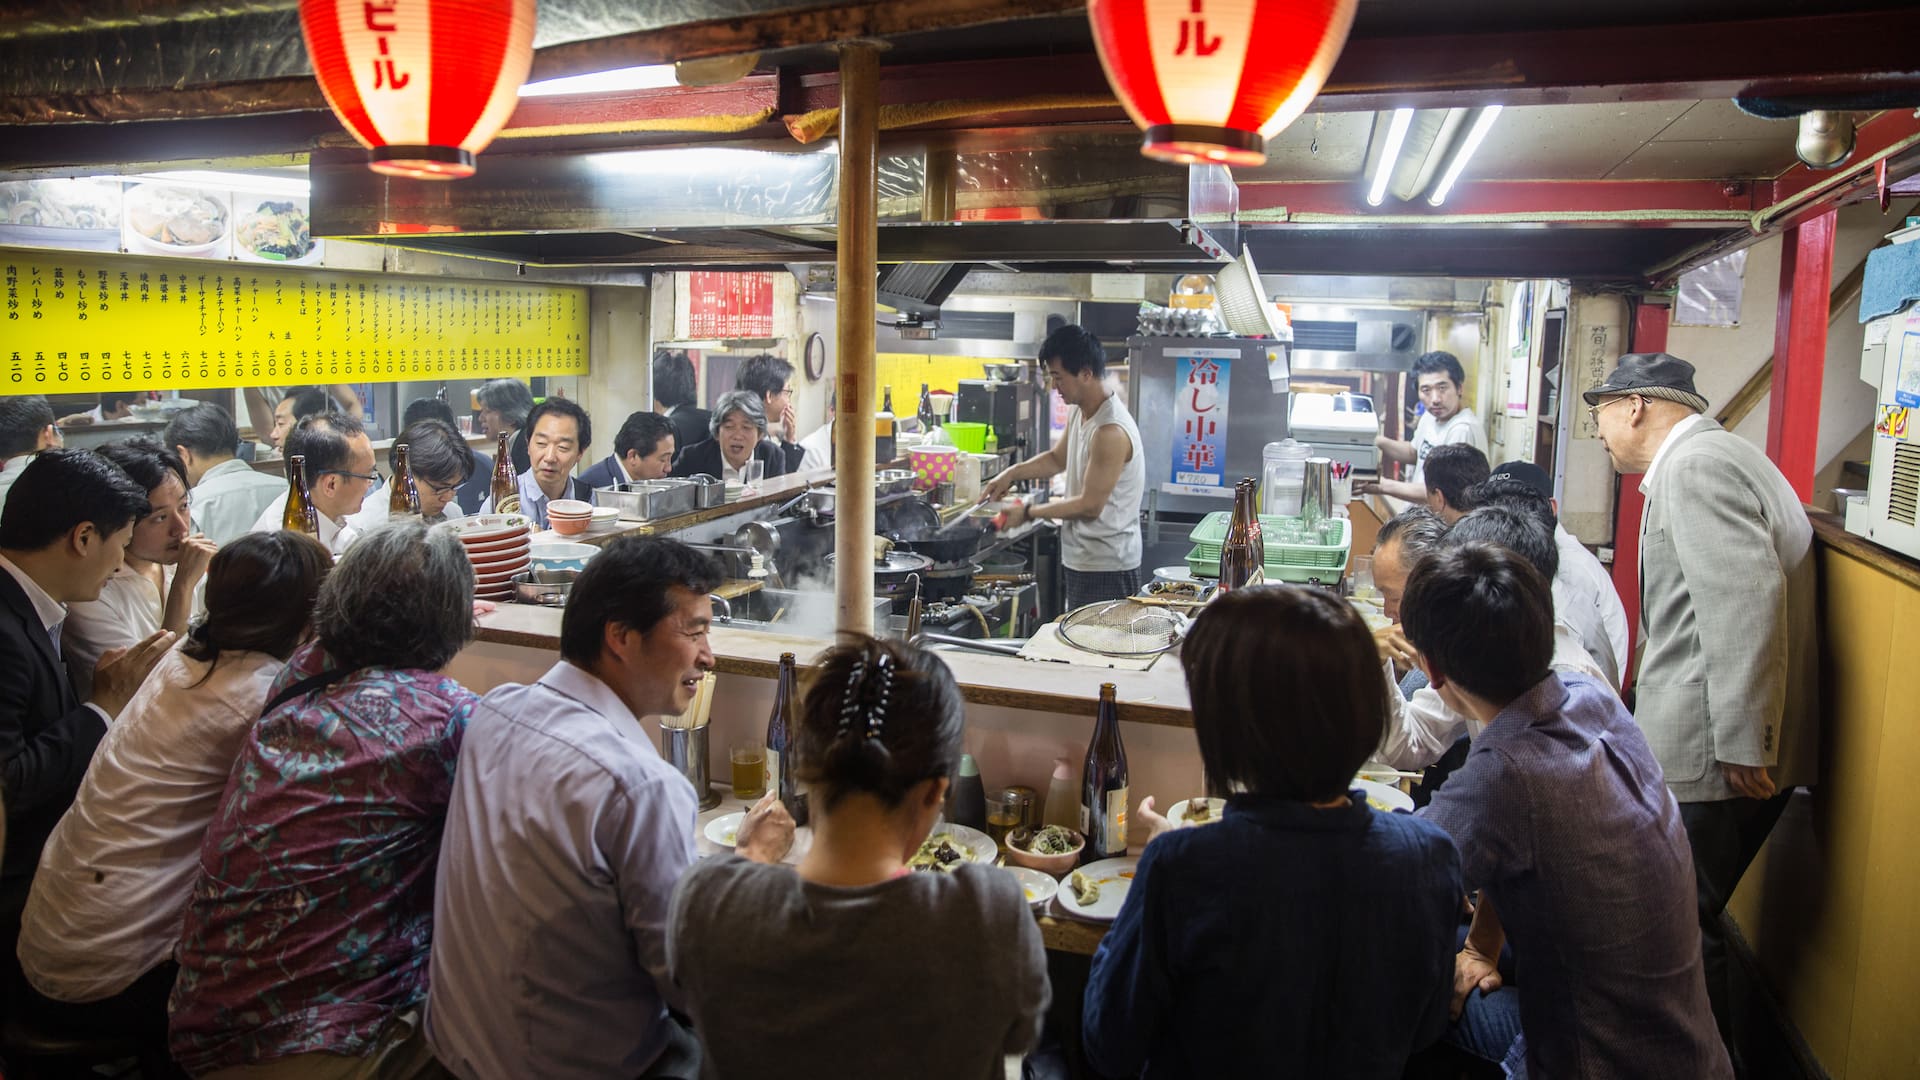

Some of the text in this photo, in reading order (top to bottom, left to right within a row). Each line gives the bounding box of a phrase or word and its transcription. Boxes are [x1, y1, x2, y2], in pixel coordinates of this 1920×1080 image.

[7, 265, 22, 382] 肉野菜炒め 五二〇
[32, 267, 46, 382] レバー炒め 五二〇
[77, 269, 90, 380] もやし炒め 四二〇
[98, 270, 111, 380] 野菜炒め 四二〇
[120, 272, 132, 379] 天津丼 七七〇
[140, 273, 152, 379] 焼肉丼 七二〇
[160, 273, 171, 379] 麻婆丼 七二〇
[179, 274, 190, 378] 中華丼 六二〇
[198, 276, 208, 377] ザーサイチャーハン 七二〇
[216, 276, 224, 333] キムチチャーハン
[58, 352, 68, 381] 四七〇
[268, 350, 276, 376] 三〇〇
[1182, 358, 1220, 471] 冷し中華
